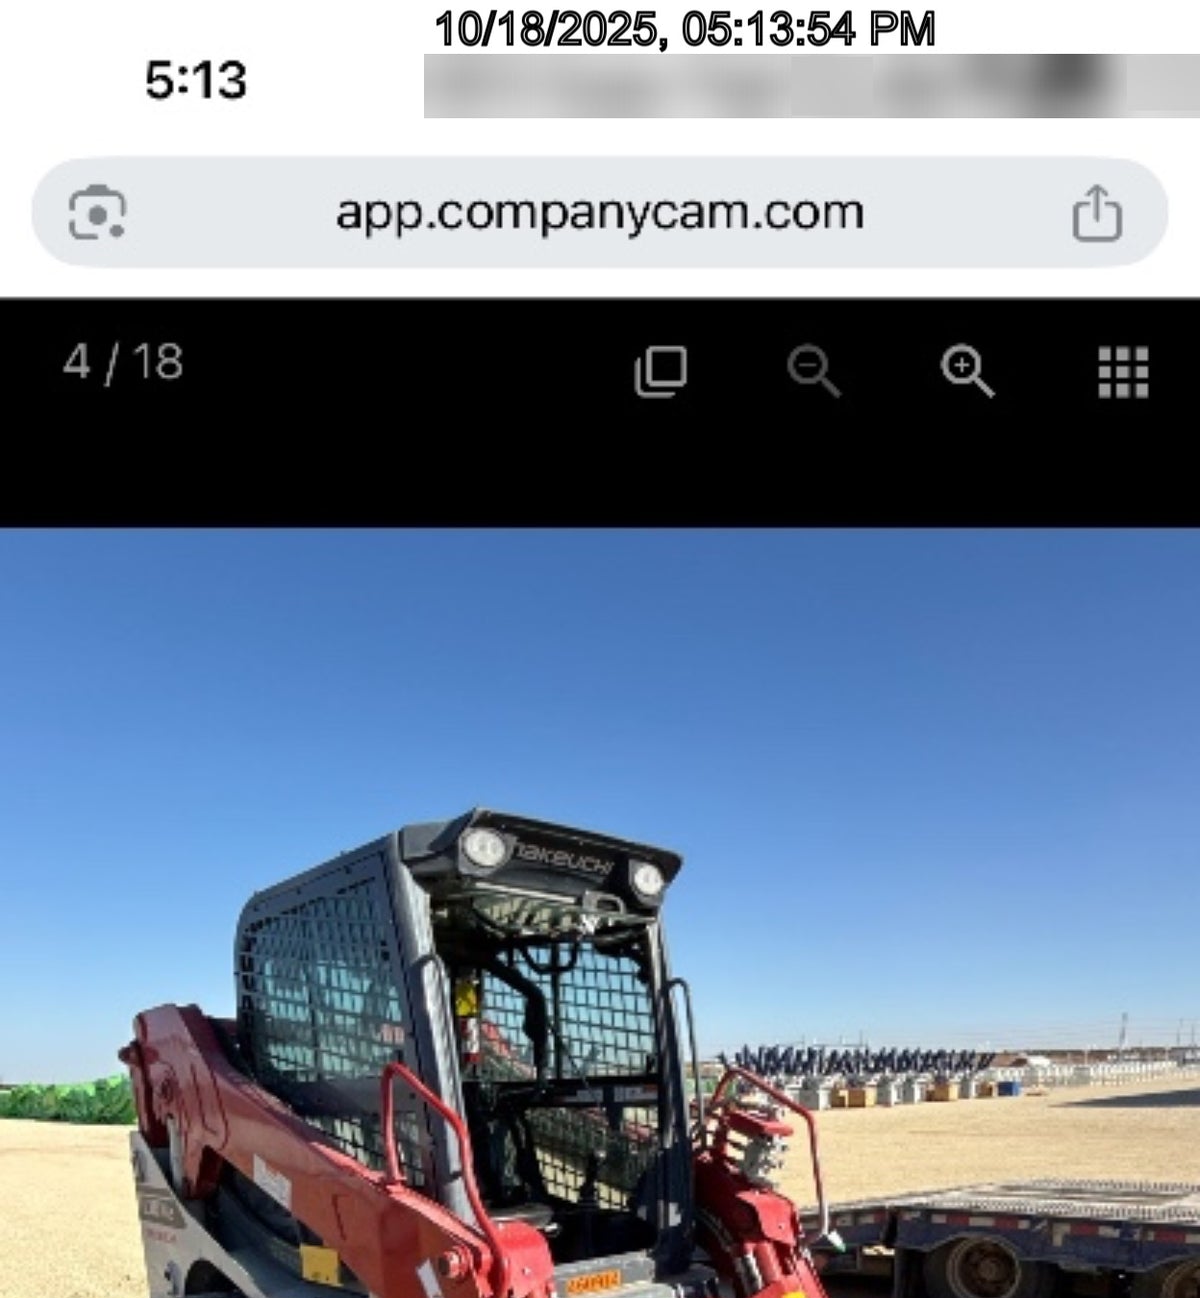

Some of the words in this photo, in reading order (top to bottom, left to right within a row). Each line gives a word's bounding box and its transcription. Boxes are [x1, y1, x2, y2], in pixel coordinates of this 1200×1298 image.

[145, 60, 247, 102] 5:13
[336, 194, 865, 241] app.companycam.com
[63, 342, 91, 379] 4
[134, 342, 184, 380] 18
